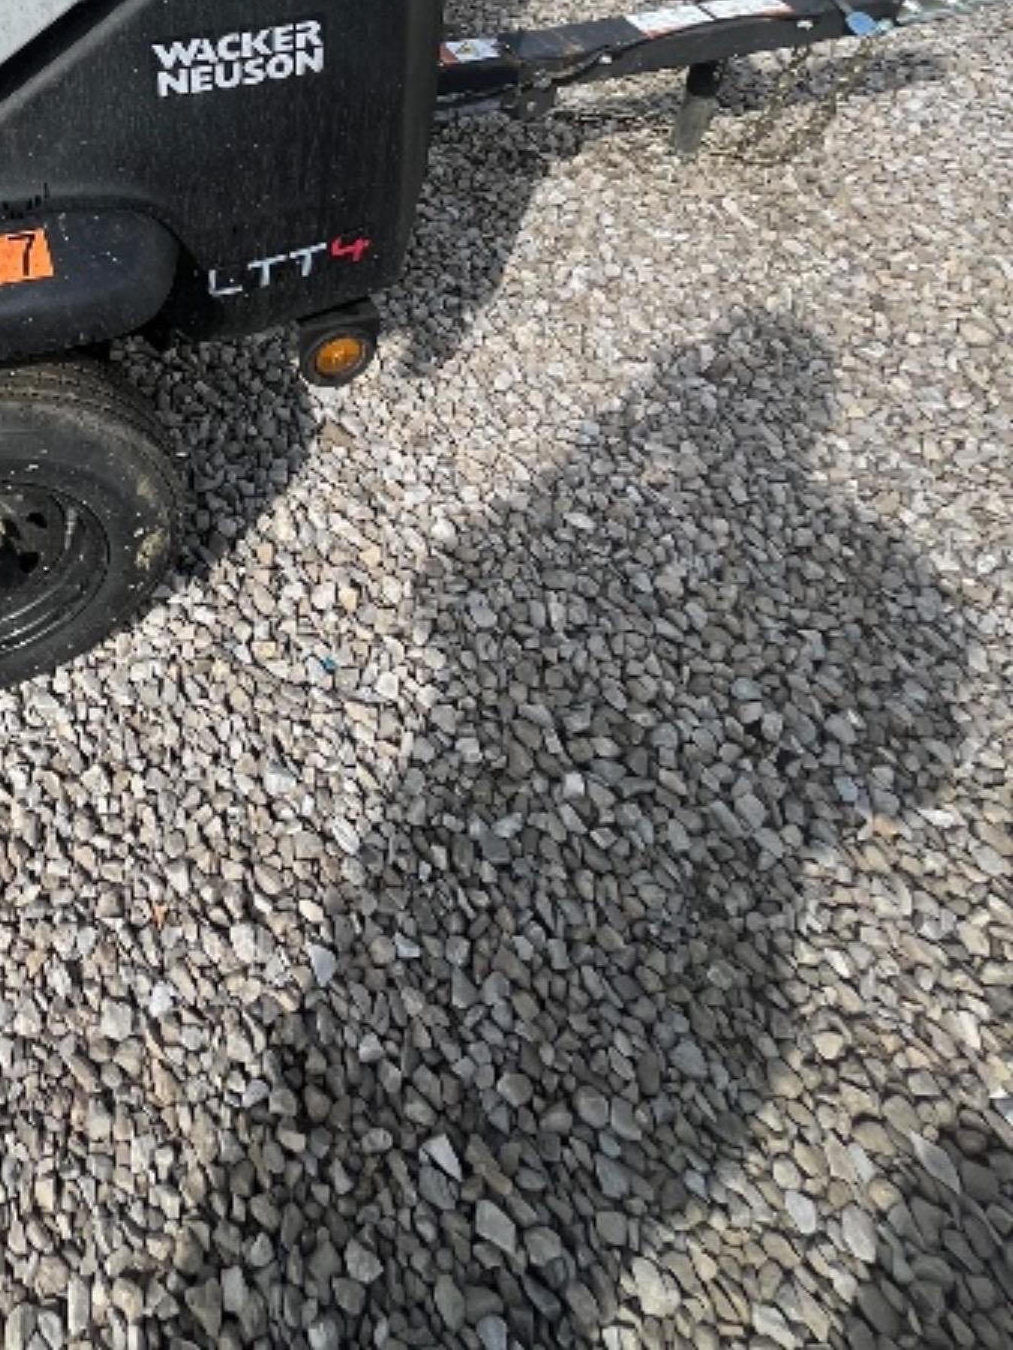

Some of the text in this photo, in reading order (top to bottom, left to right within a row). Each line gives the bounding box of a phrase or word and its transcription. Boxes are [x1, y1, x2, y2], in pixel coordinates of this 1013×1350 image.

[151, 20, 324, 69] WACKER
[157, 47, 325, 98] NEUSON
[207, 236, 372, 297] LTT4
